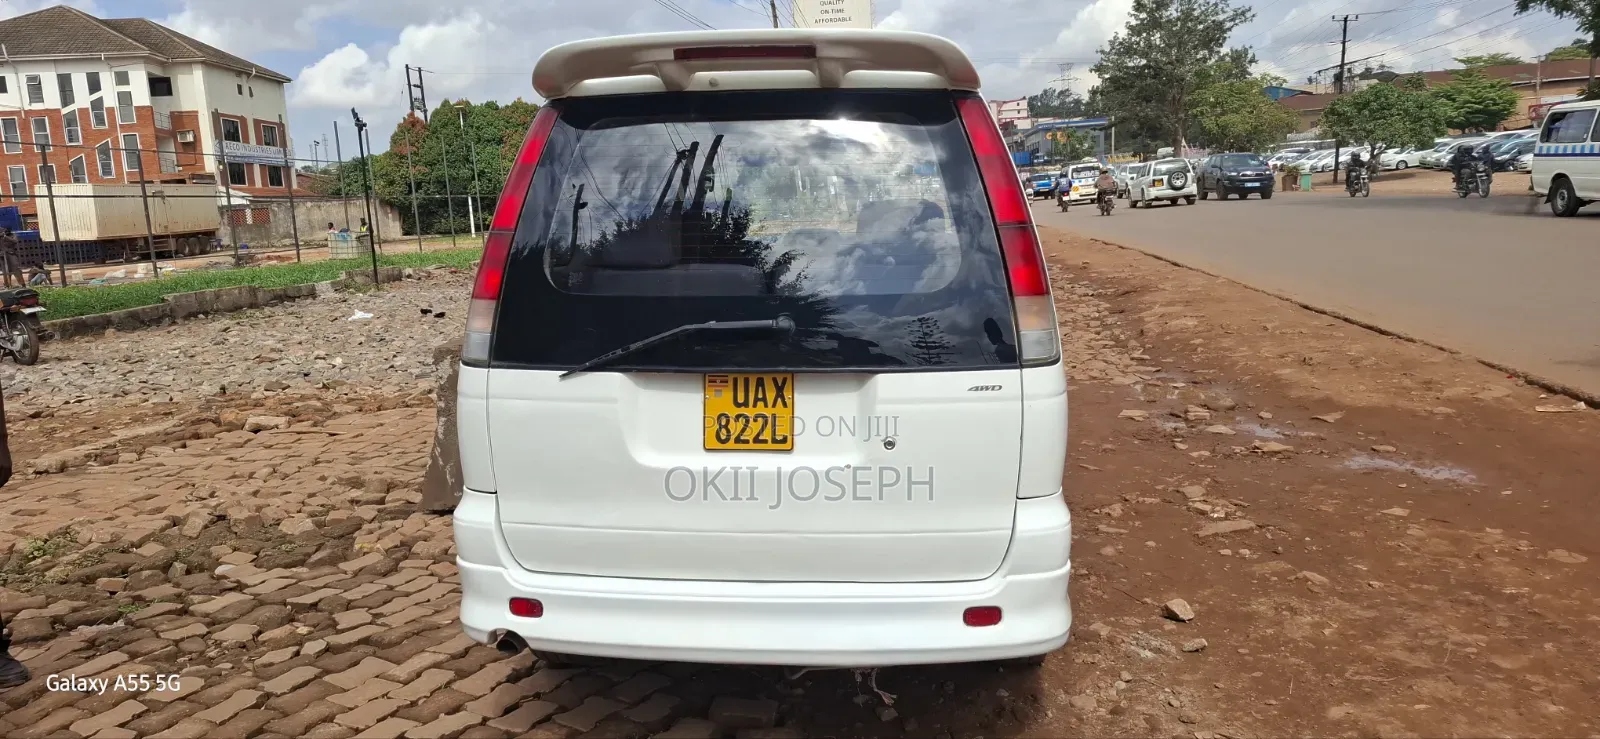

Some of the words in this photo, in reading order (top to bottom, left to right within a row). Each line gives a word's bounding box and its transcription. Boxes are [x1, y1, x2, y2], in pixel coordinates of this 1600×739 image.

[814, 16, 853, 24] AFFORDABLE
[241, 144, 272, 155] INDUSTRIES
[732, 376, 788, 408] UAX
[715, 413, 788, 445] 822L
